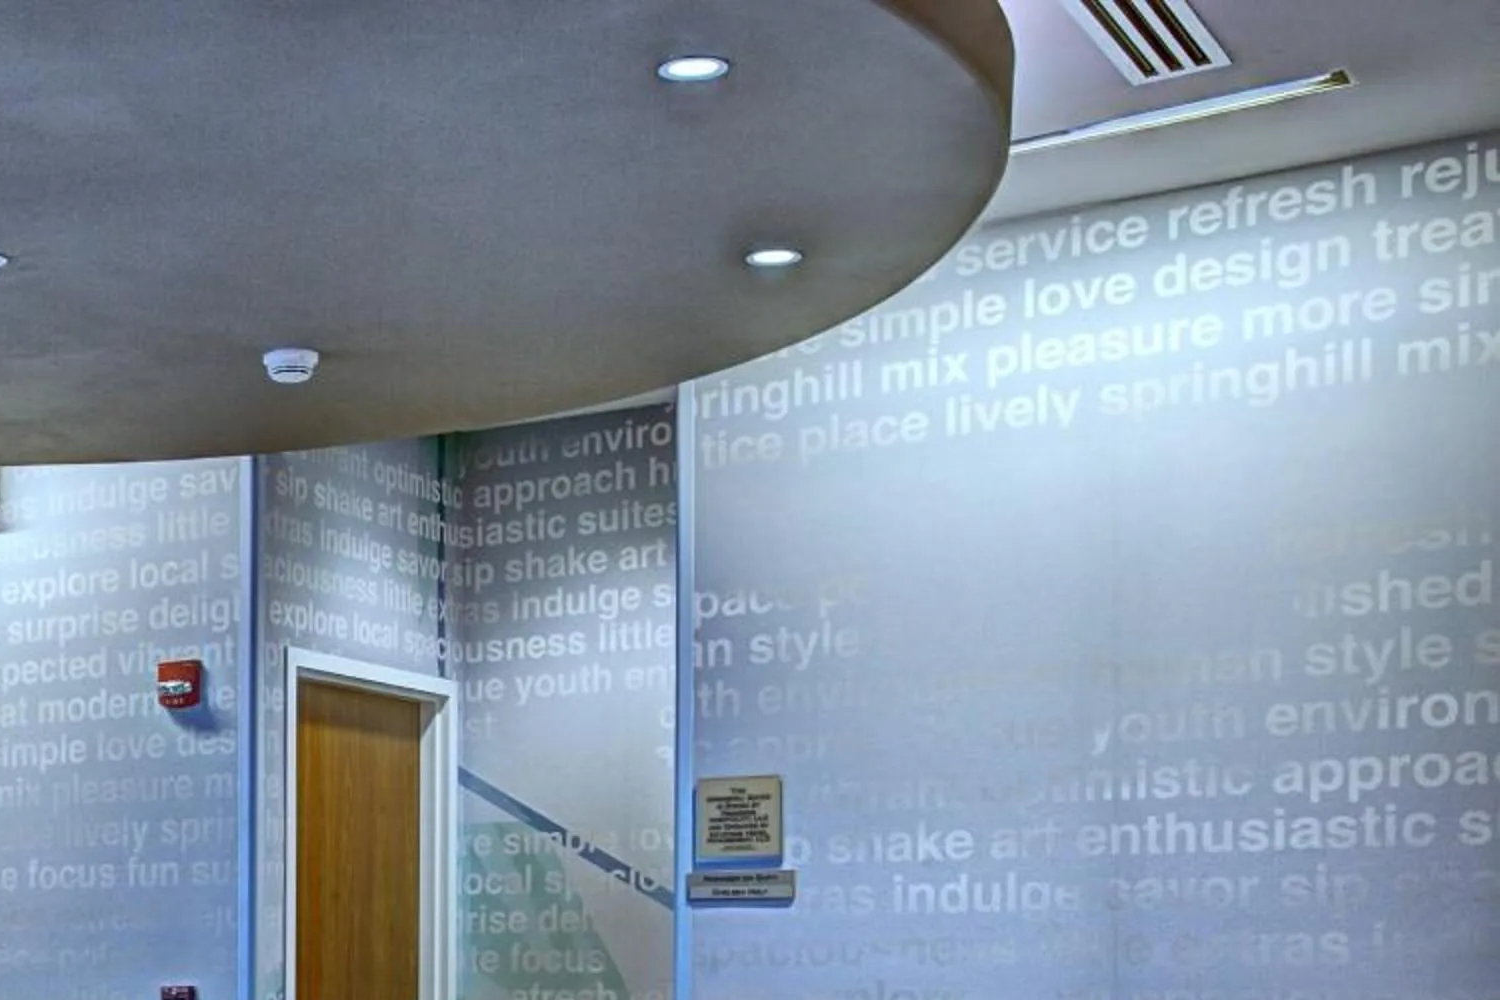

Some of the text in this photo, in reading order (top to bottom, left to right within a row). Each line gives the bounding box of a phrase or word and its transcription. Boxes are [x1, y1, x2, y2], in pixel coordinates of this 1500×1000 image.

[955, 214, 1149, 276] service
[1167, 165, 1377, 241] refresh
[839, 208, 1500, 347] simple love design trea
[880, 339, 971, 395] mix
[987, 311, 1225, 390] pleasure
[1241, 285, 1399, 342] more
[799, 409, 930, 468] place
[945, 384, 1082, 437] lively
[1099, 336, 1373, 421] springhill
[1397, 322, 1500, 376] mix
[50, 474, 168, 515] indulge
[275, 465, 308, 503] sip
[314, 477, 373, 521] shake
[377, 500, 404, 531] art
[406, 508, 568, 548] enthusiastic
[373, 461, 463, 509] optimistic
[474, 460, 637, 514] approach
[156, 505, 230, 545] little
[1, 566, 120, 609] explore
[130, 548, 208, 590] local
[320, 519, 392, 574] indulge
[398, 548, 448, 581] savor
[451, 558, 495, 593] sip
[504, 545, 609, 583] shake
[618, 540, 668, 571] art
[383, 577, 423, 616] little
[512, 584, 642, 621] indulge
[7, 608, 139, 647] surprise
[269, 599, 675, 662] explore local spaciousness little
[749, 619, 861, 671] style
[1304, 625, 1453, 687] style
[37, 688, 165, 724] modern
[514, 661, 612, 706] youth
[1264, 686, 1500, 738] environ
[97, 731, 167, 762] love
[52, 771, 194, 816] pleasure
[1271, 750, 1500, 803] approa
[989, 818, 1062, 857] art
[1076, 803, 1438, 856] enthusiastic
[27, 858, 116, 889] focus
[128, 856, 179, 888] fun
[891, 870, 1082, 916] indulge
[512, 942, 607, 973] focus
